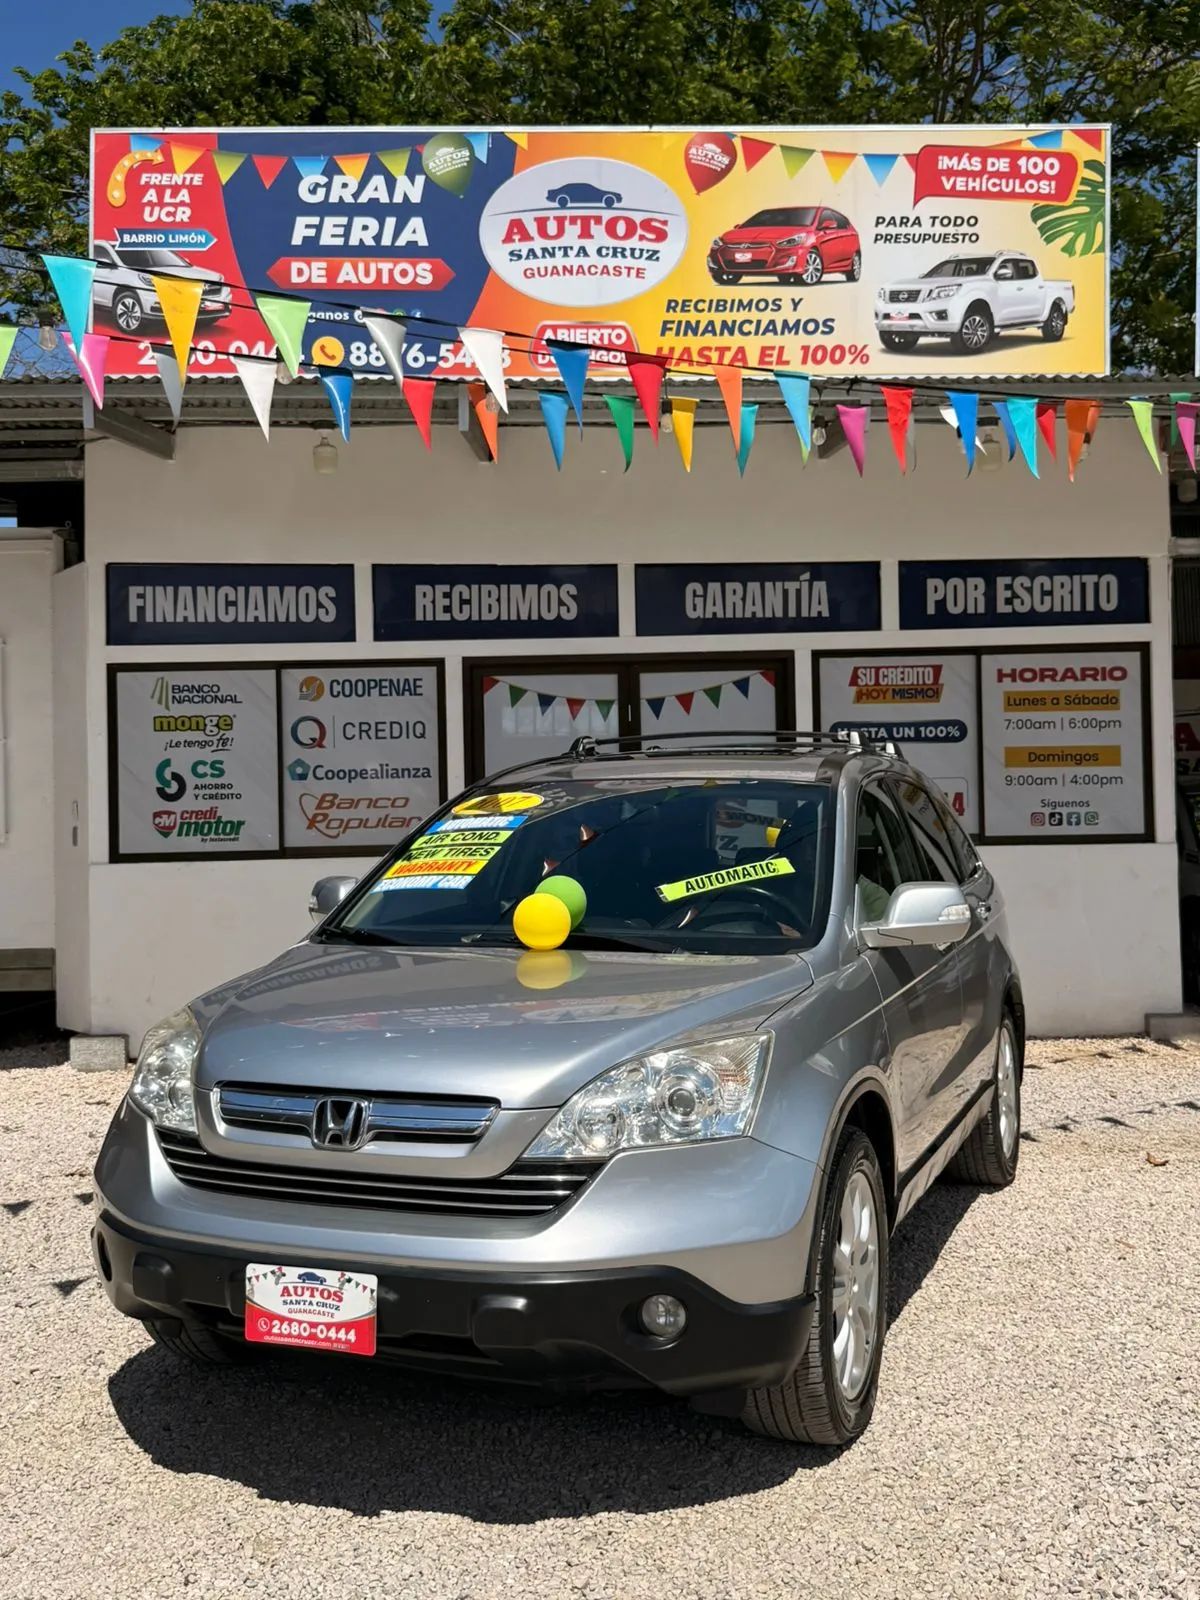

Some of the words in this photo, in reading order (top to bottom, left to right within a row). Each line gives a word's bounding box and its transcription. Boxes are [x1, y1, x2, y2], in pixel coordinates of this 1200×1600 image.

[938, 153, 982, 171] ¡MÁS
[986, 158, 1010, 172] DE
[1018, 156, 1060, 176] 100
[140, 173, 204, 186] FRENTE
[941, 173, 1056, 195] VEHÍCULOS!
[141, 188, 159, 203] A
[163, 188, 191, 203] LA
[297, 174, 426, 204] GRAN
[143, 206, 192, 223] UCR
[874, 215, 923, 229] PARA
[929, 215, 979, 229] TODO
[123, 233, 166, 243] BARRIO
[168, 231, 206, 243] LIMÓN
[290, 215, 430, 247] FERIA
[501, 214, 669, 244] AUTOS
[873, 232, 980, 245] PRESUPUESTO
[508, 245, 590, 263] SANTA
[596, 247, 661, 263] CRUZ
[290, 262, 328, 284] DE
[336, 262, 433, 285] AUTOS
[522, 263, 646, 280] GUANACASTE
[665, 297, 784, 314] RECIBIMOS
[789, 297, 803, 313] Y
[541, 328, 627, 345] ABIERTO
[660, 318, 836, 338] FINANCIAMOS
[655, 346, 749, 367] HASTA
[758, 345, 790, 366] EL
[799, 344, 871, 366] 100%
[414, 583, 578, 622] RECIBIMOS
[685, 573, 830, 619] GARANTÍA
[926, 577, 986, 615] POR
[995, 574, 1119, 614] ESCRITO
[128, 585, 337, 624] FINANCIAMOS
[857, 668, 875, 686] SU
[996, 666, 1128, 683] HORARIO
[171, 684, 221, 694] BANCO
[329, 678, 424, 698] COOPENAE
[892, 688, 940, 700] MISMO!
[171, 694, 243, 704] NACIONAL
[1007, 695, 1047, 707] Lunes
[1051, 697, 1060, 706] a
[1064, 692, 1119, 706] Sábado
[153, 714, 234, 737] monge
[342, 720, 427, 740] CREDIQ
[892, 726, 915, 738] UN
[919, 725, 960, 738] 100%
[1003, 718, 1056, 731] 7:00am
[1068, 717, 1122, 732] 6:00pm
[183, 739, 215, 749] tengo
[1027, 751, 1100, 765] Domingos
[190, 759, 226, 779] CS
[312, 764, 432, 784] Coopealianza
[193, 783, 234, 791] AHORRO
[1004, 774, 1058, 788] 9:00am
[1069, 773, 1124, 789] 4:00pm
[193, 793, 200, 801] Y
[202, 792, 242, 801] CRÉDITO
[315, 792, 410, 811] Banco
[180, 806, 219, 820] credi
[177, 816, 246, 837] motor
[306, 812, 423, 835] Popular
[420, 834, 447, 847] AIR
[450, 831, 499, 843] COND.
[401, 848, 441, 862] NEW
[443, 846, 496, 858] TIRES
[392, 860, 478, 876] WARRANTY
[685, 861, 777, 893] AUTOMATIC
[280, 1285, 344, 1303] AUTOS
[282, 1299, 314, 1307] SANTA
[316, 1301, 341, 1312] CRUZ
[287, 1307, 335, 1319] GUANACASTE
[271, 1319, 357, 1343] 2680-0444
